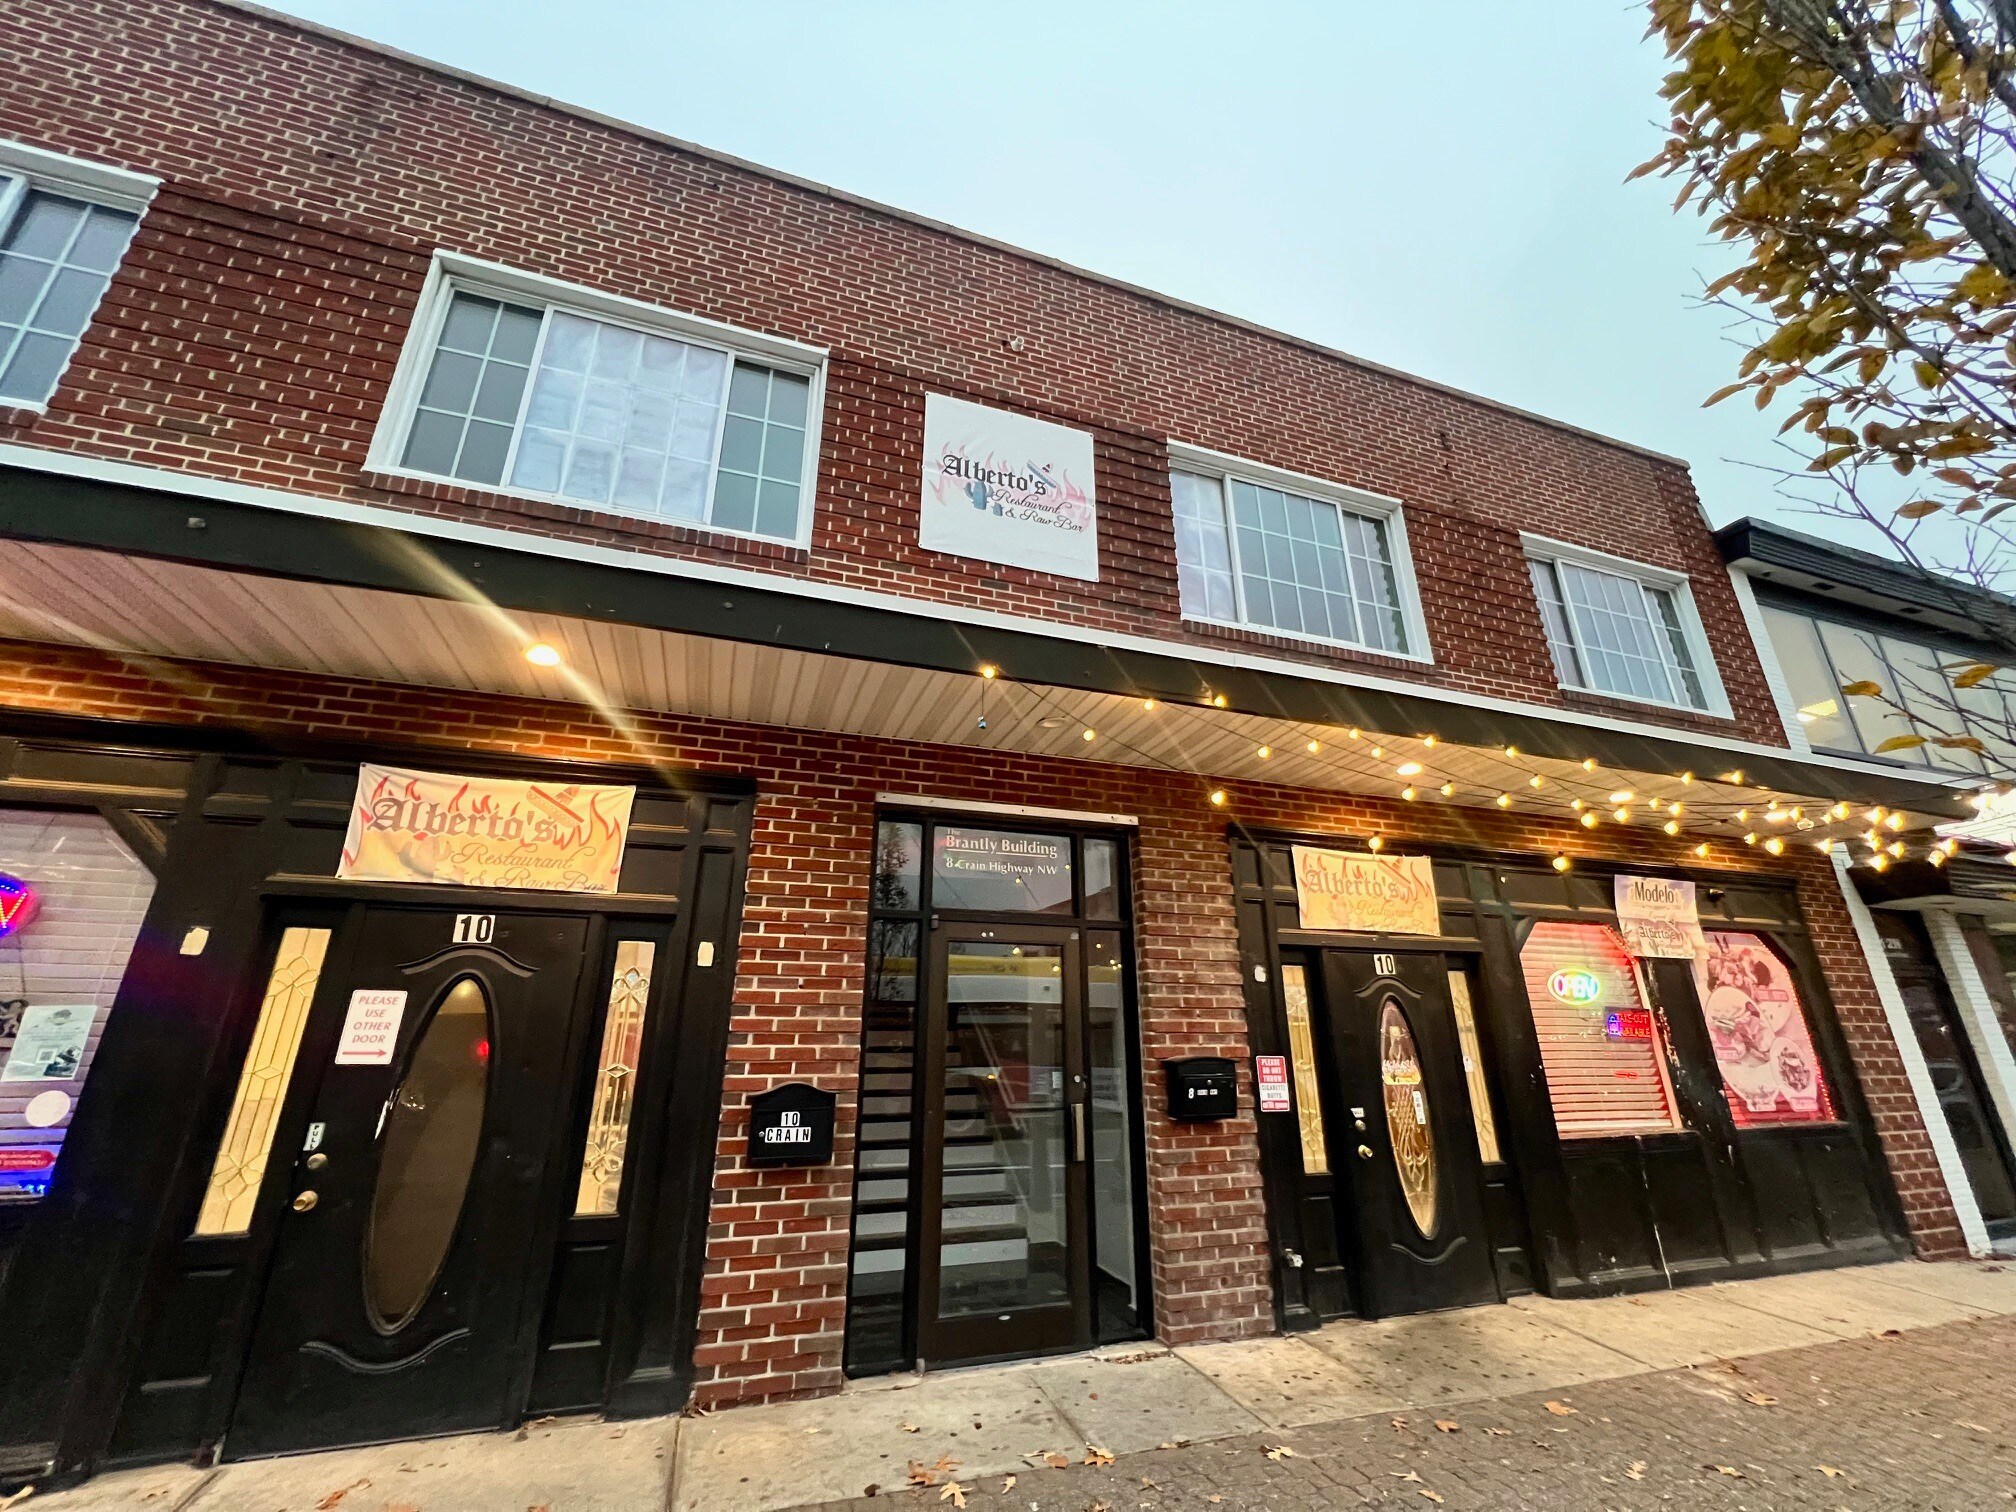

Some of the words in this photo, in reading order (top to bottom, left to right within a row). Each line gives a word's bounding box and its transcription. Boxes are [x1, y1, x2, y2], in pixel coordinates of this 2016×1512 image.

[942, 454, 1047, 496] Alberto's
[991, 488, 1072, 515] Restaurant
[1005, 507, 1016, 519] &
[1019, 509, 1052, 525] Raw
[1053, 515, 1083, 533] Bar
[367, 797, 555, 844] Alberto's
[451, 842, 597, 869] Restaurant
[946, 835, 998, 854] Brantly
[1001, 839, 1058, 859] Building
[946, 857, 953, 868] 8
[957, 859, 986, 870] Crain
[989, 861, 1034, 875] Highway
[1037, 865, 1058, 875] NW
[470, 870, 487, 886] &
[1306, 869, 1400, 899] Alberto's
[1634, 881, 1675, 904] Modelo
[461, 916, 492, 942] 10
[1376, 955, 1394, 974] 10
[1553, 974, 1598, 1000] OPEN
[358, 996, 400, 1005] PLEASE
[365, 1009, 387, 1018] USE
[353, 1021, 392, 1031] OTHER
[352, 1034, 386, 1044] DOOR
[1188, 1087, 1194, 1099] 8
[785, 1113, 798, 1125] 10
[308, 1125, 320, 1150] PULL
[767, 1129, 809, 1141] CRAIN
